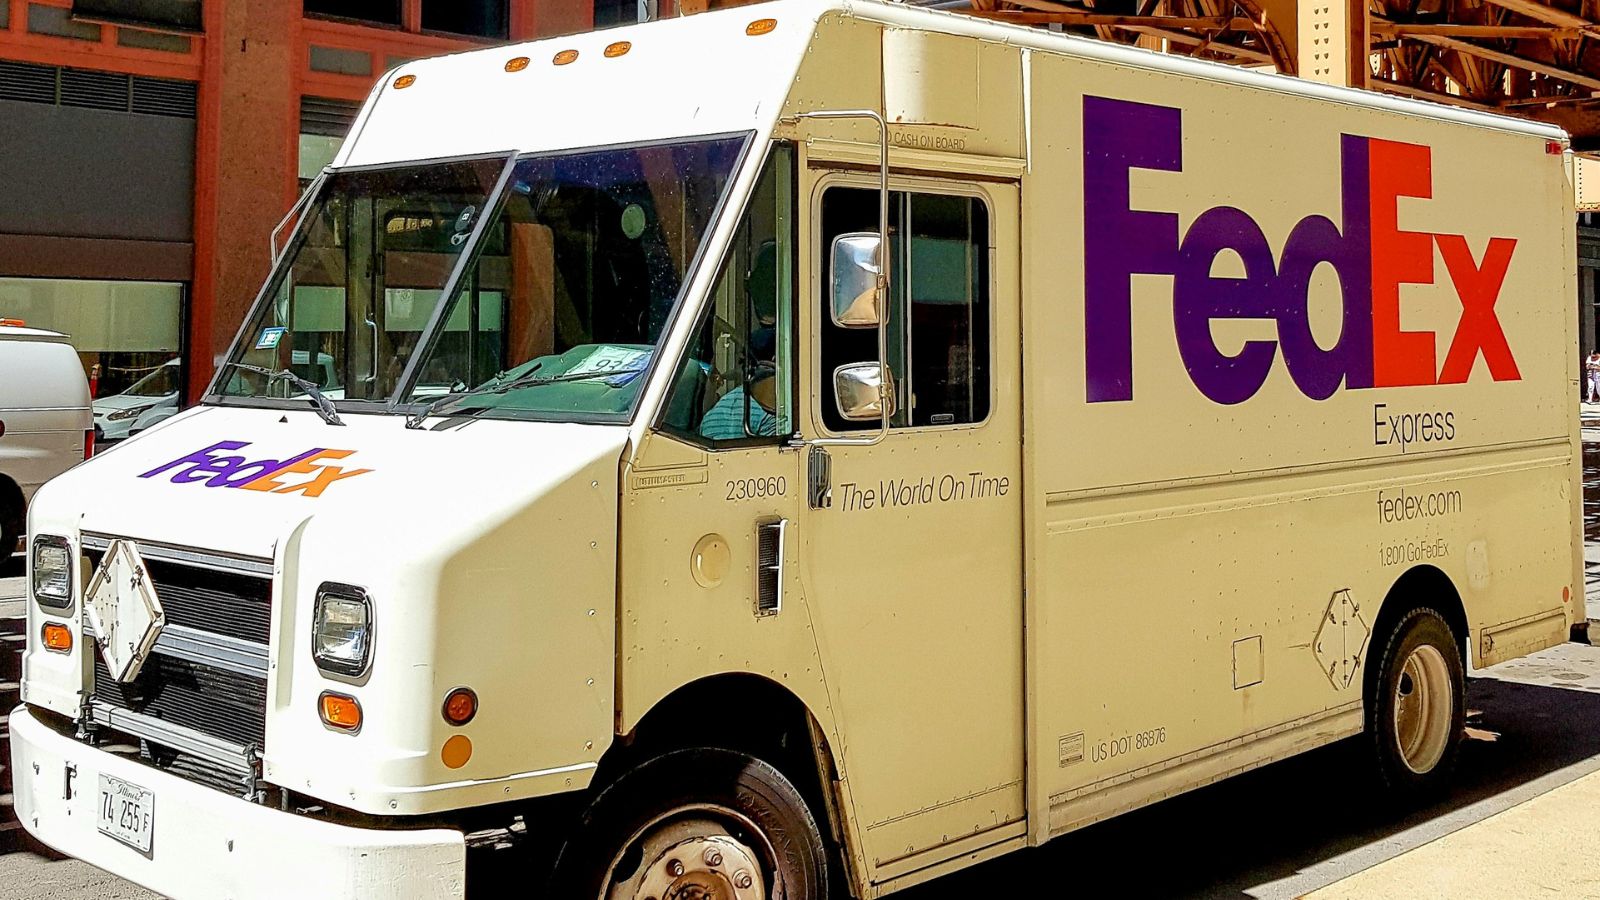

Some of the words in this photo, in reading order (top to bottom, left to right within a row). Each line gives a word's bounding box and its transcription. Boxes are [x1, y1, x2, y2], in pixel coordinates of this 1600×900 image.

[894, 132, 918, 146] CASH
[920, 135, 933, 147] ON
[935, 137, 965, 151] BOARD
[1083, 95, 1521, 404] FedEx
[1374, 403, 1455, 453] Express
[136, 440, 376, 497] FedEx
[726, 476, 786, 500] 230960
[840, 483, 875, 511] The
[880, 476, 934, 507] World
[939, 475, 965, 502] On
[968, 472, 1009, 498] Time
[1377, 488, 1462, 524] fedex.com
[1407, 538, 1450, 562] GoFedEx
[1091, 743, 1107, 763] US
[1110, 736, 1132, 757] DOT
[1136, 727, 1166, 750] 86876
[102, 791, 114, 823] 74
[120, 800, 140, 833] 255
